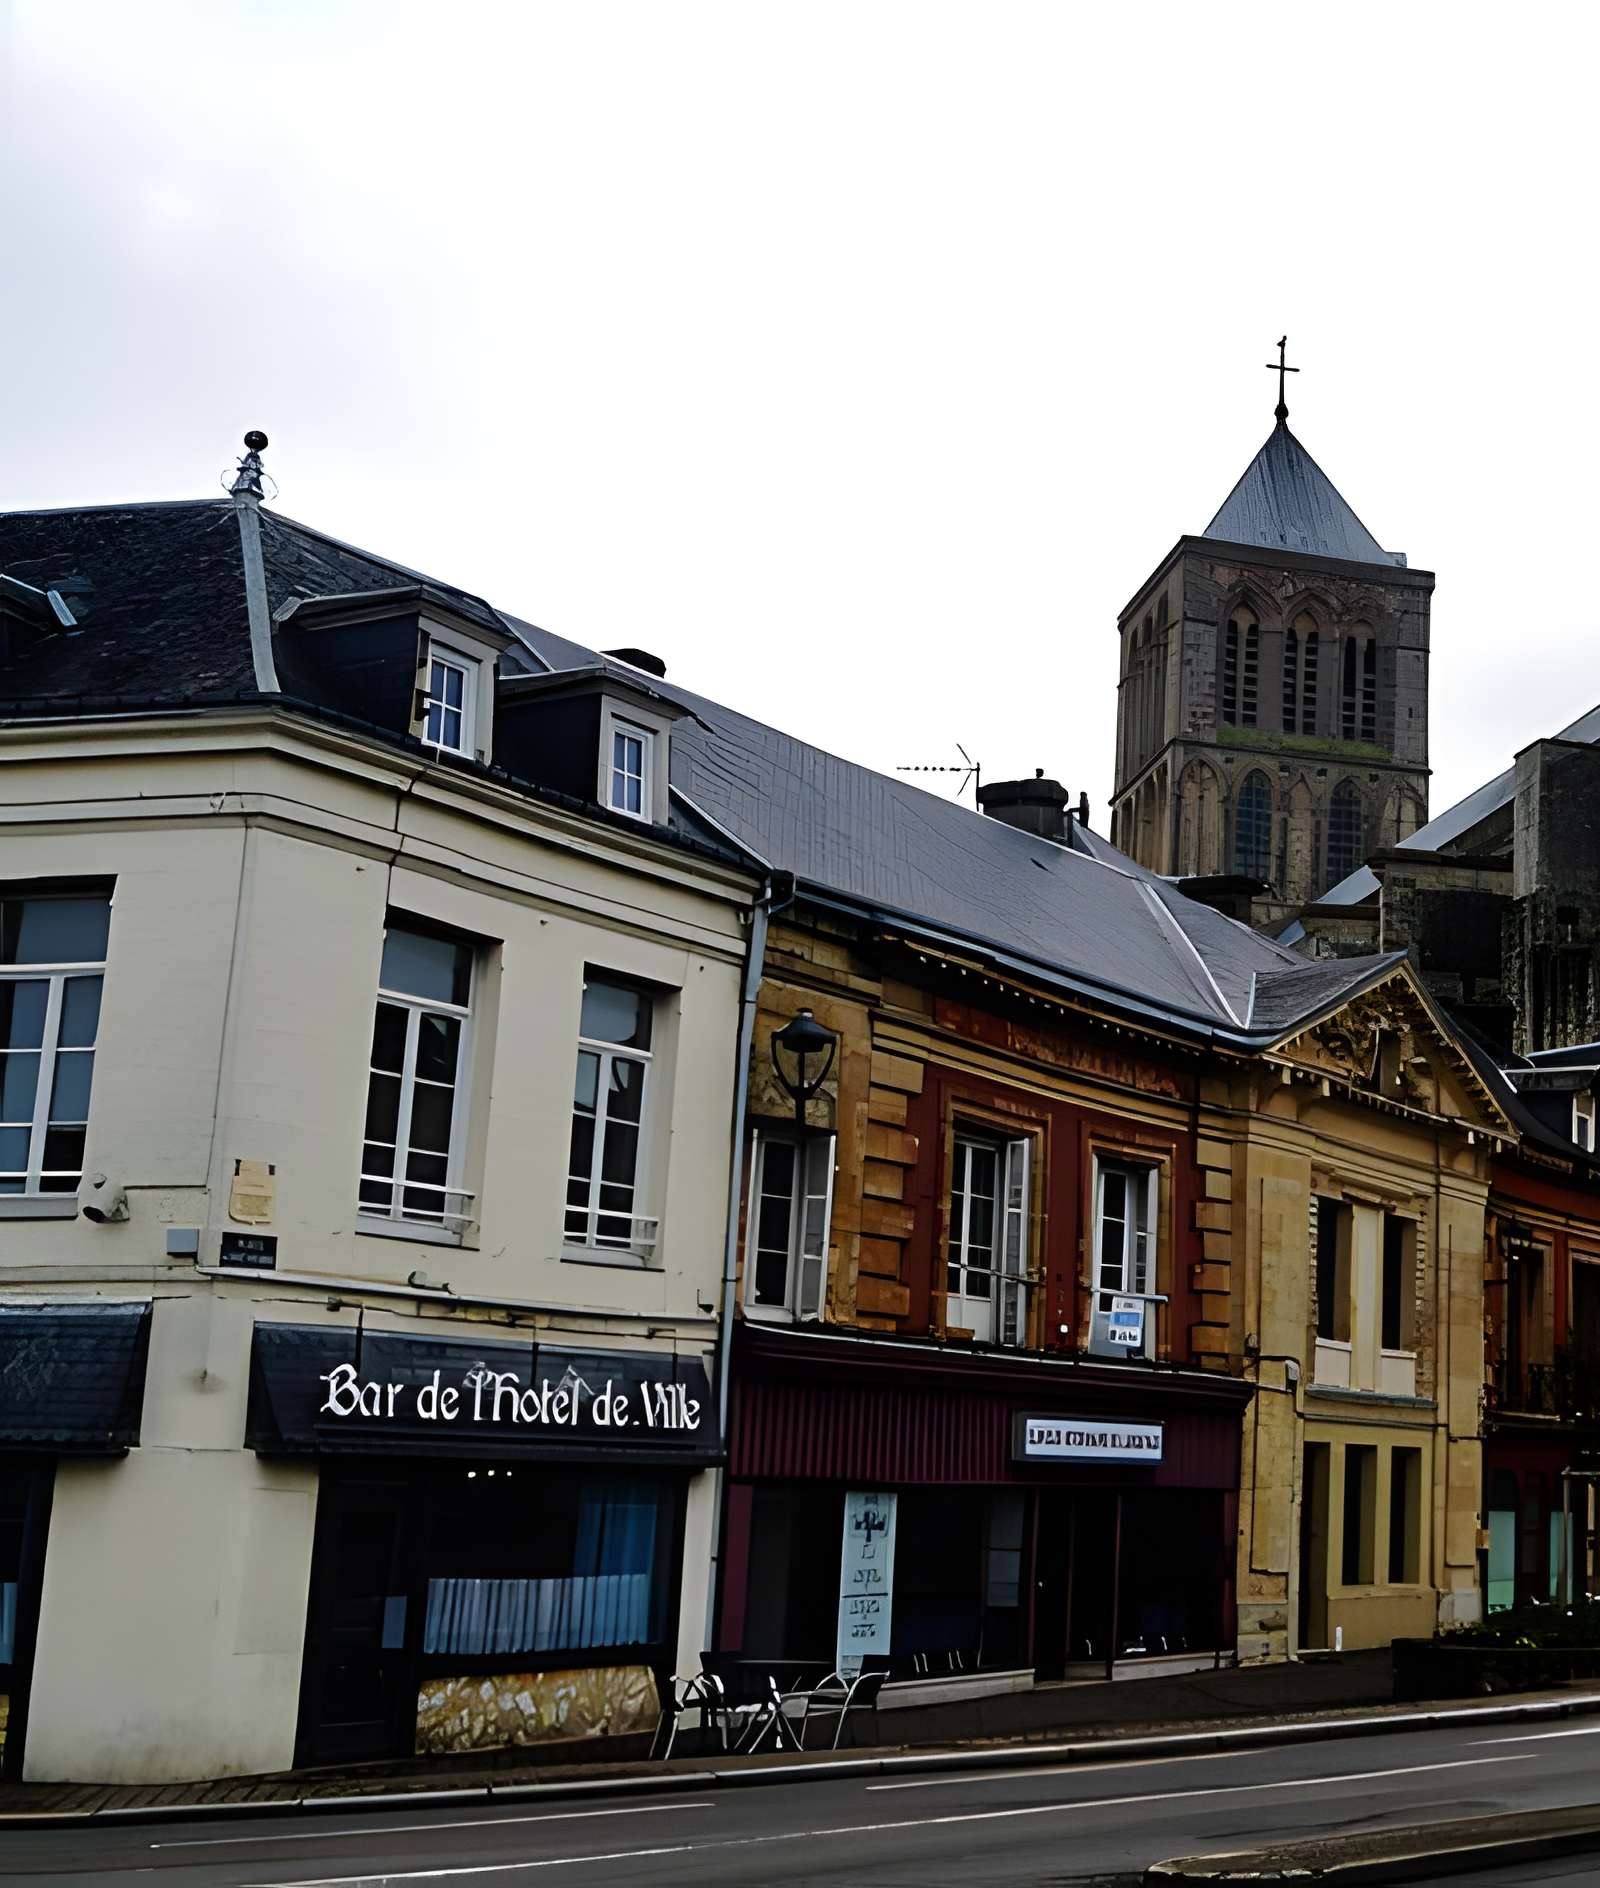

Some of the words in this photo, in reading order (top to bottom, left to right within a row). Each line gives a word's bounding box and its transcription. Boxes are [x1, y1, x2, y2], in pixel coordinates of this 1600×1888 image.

[320, 1363, 404, 1417] Bar
[417, 1369, 459, 1420] de
[592, 1379, 629, 1427] de
[640, 1380, 701, 1430] Ville
